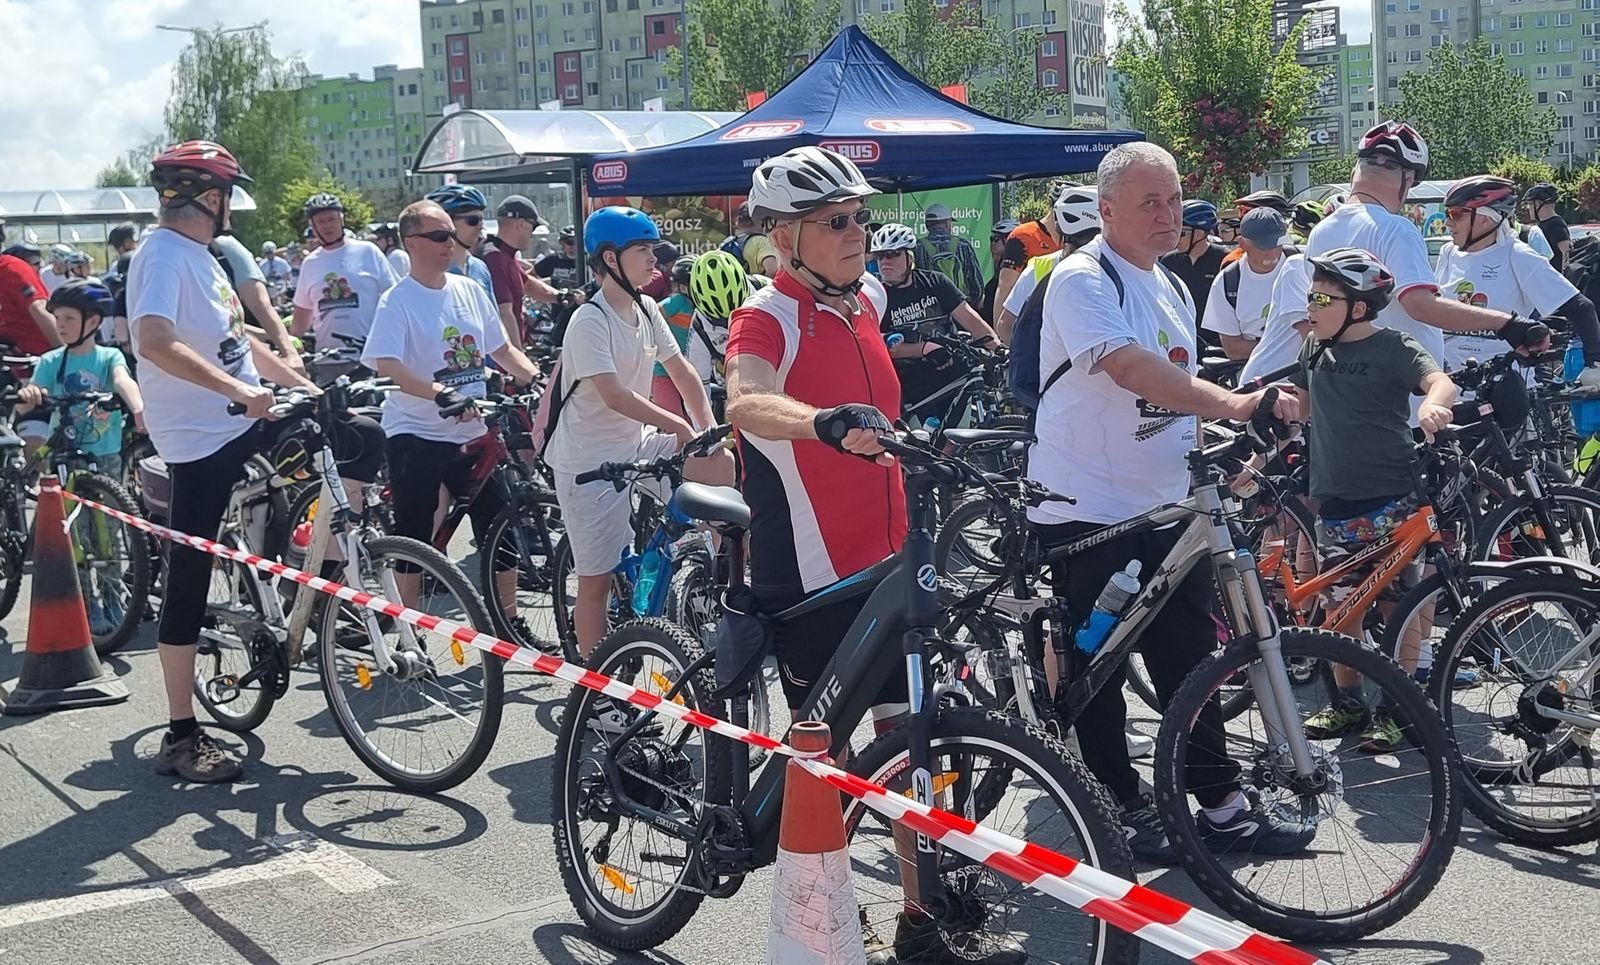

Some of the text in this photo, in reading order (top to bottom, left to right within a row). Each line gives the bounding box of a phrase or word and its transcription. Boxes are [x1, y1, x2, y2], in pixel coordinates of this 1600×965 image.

[1073, 56, 1105, 98] CENY!
[597, 166, 624, 179] ABUS
[654, 815, 680, 832] ESKUTE
[557, 819, 573, 868] KENDA
